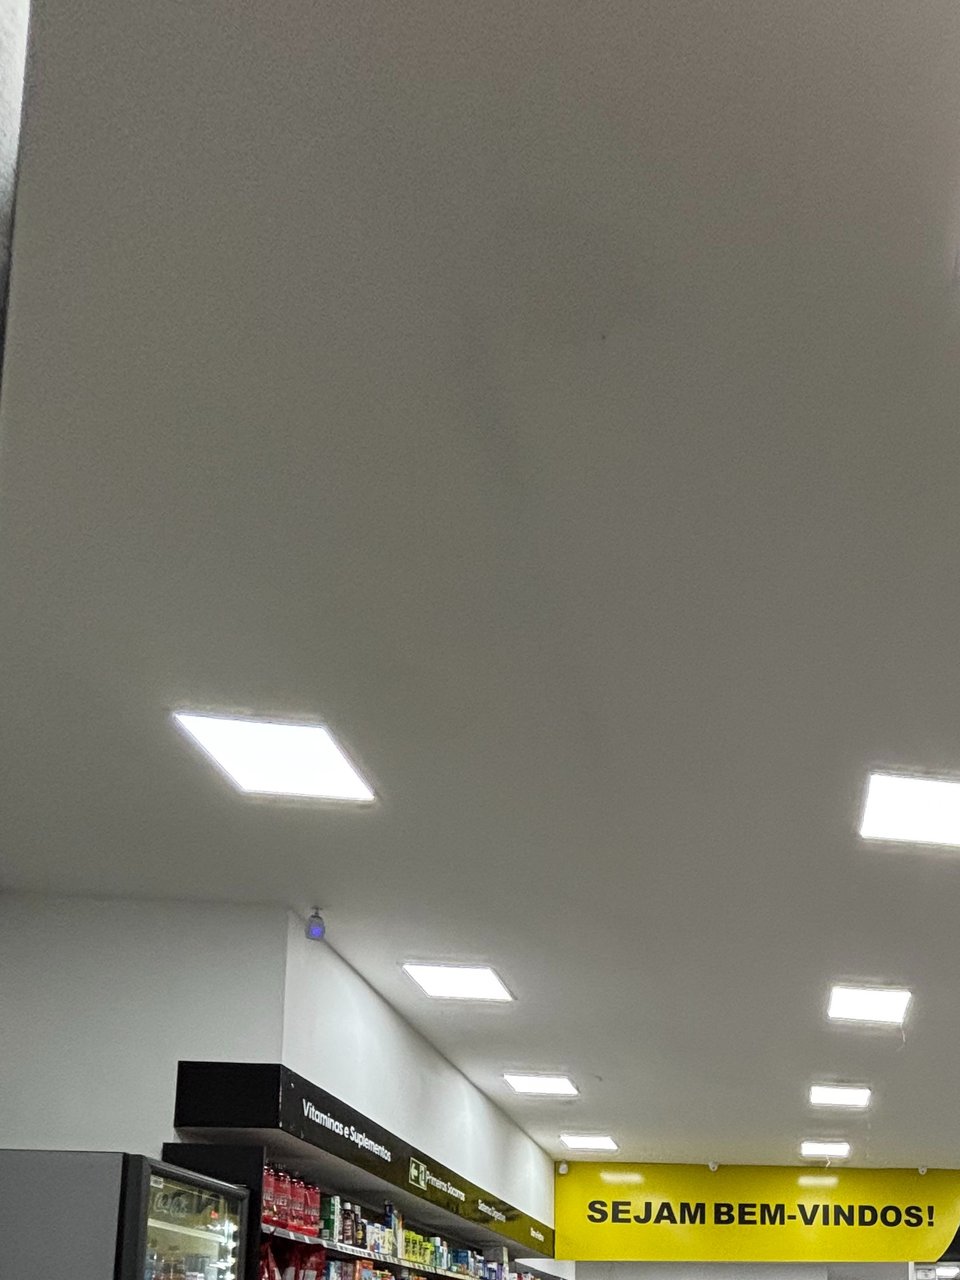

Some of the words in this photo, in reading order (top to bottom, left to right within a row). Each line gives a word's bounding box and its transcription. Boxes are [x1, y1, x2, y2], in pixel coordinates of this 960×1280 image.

[303, 1098, 343, 1136] Vitaminas
[344, 1125, 350, 1139] e
[350, 1127, 391, 1162] Suplementos
[587, 1200, 706, 1225] SEJAM
[713, 1203, 935, 1228] BEM-VINDOS!
